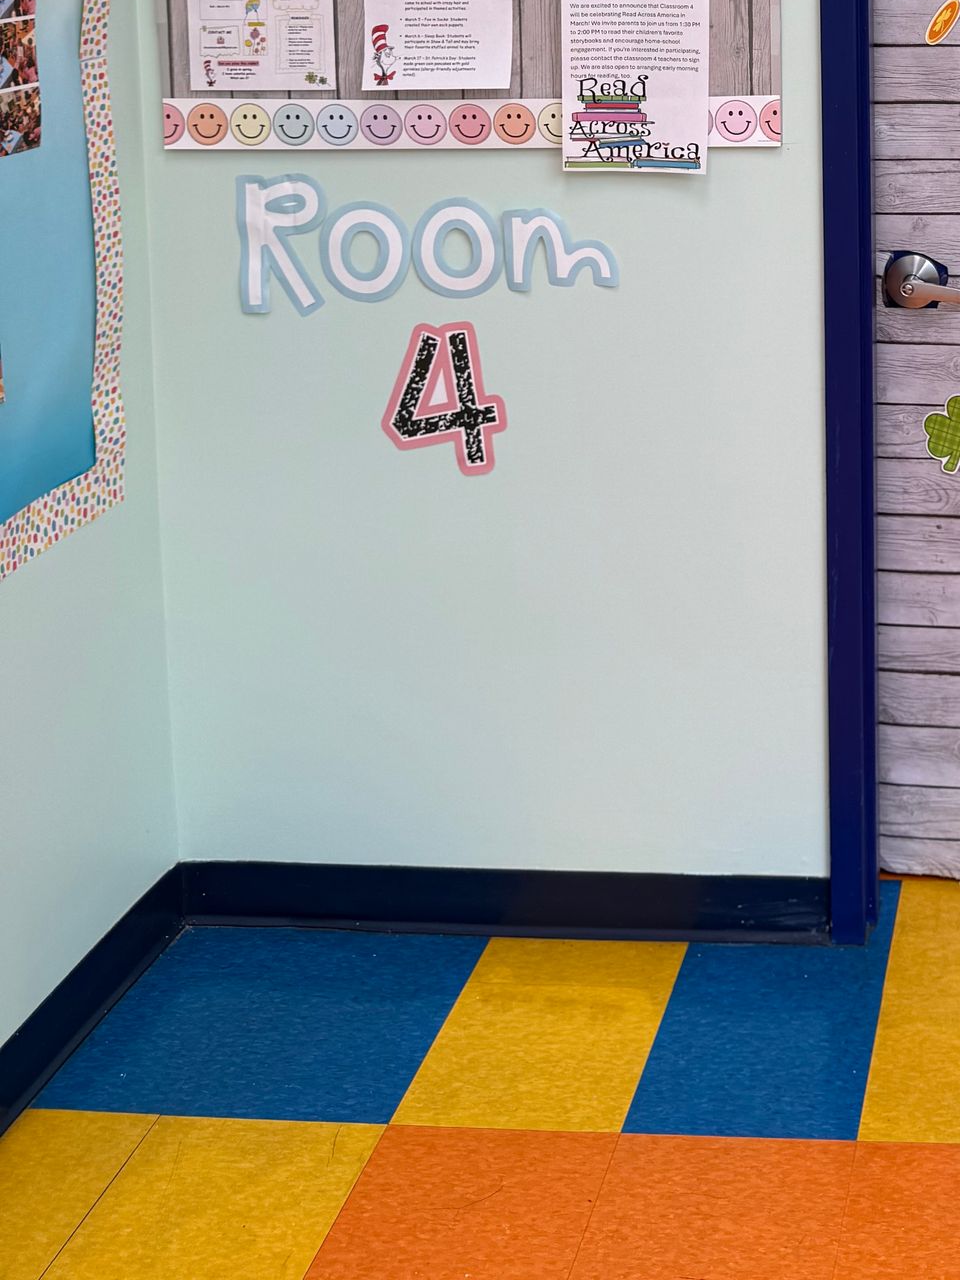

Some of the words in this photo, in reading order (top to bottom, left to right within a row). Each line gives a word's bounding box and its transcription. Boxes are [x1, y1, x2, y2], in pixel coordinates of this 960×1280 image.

[576, 75, 649, 103] Read
[569, 121, 651, 139] Across
[582, 140, 700, 162] America
[239, 177, 616, 313] Room
[388, 327, 502, 469] 4
